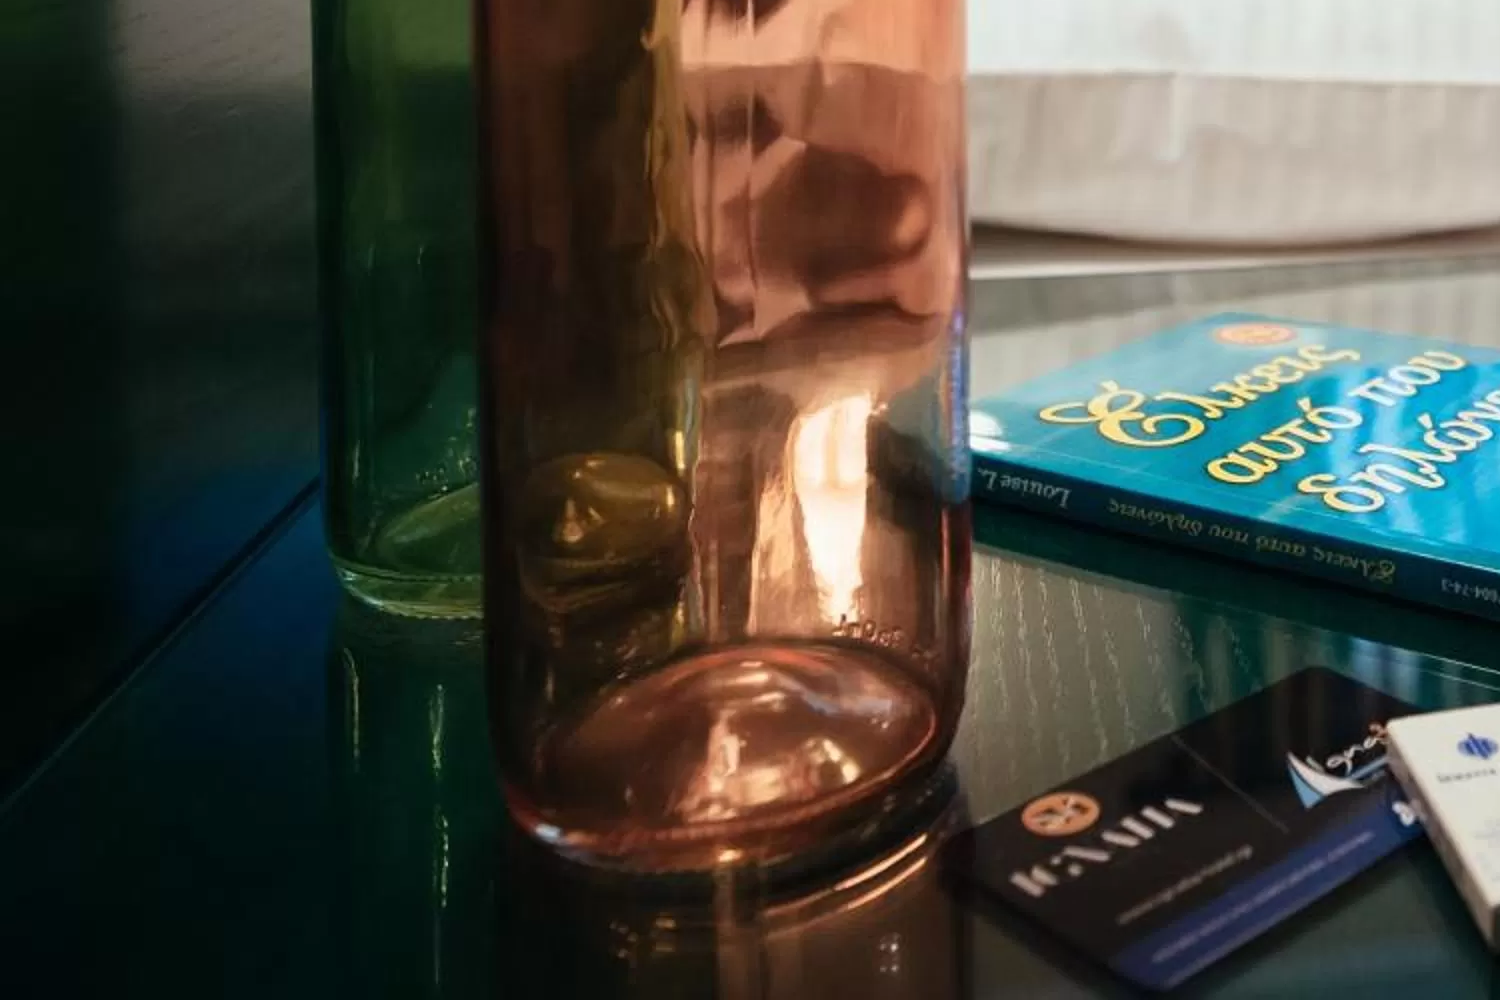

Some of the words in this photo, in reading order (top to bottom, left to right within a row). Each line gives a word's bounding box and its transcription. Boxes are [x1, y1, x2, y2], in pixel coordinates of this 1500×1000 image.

[1206, 397, 1363, 484] αυτό
[1348, 349, 1467, 408] που
[1001, 472, 1073, 509] Louise
[1108, 498, 1203, 538] δηλώνεις
[1208, 520, 1250, 551] που
[1254, 533, 1307, 563] αυτό
